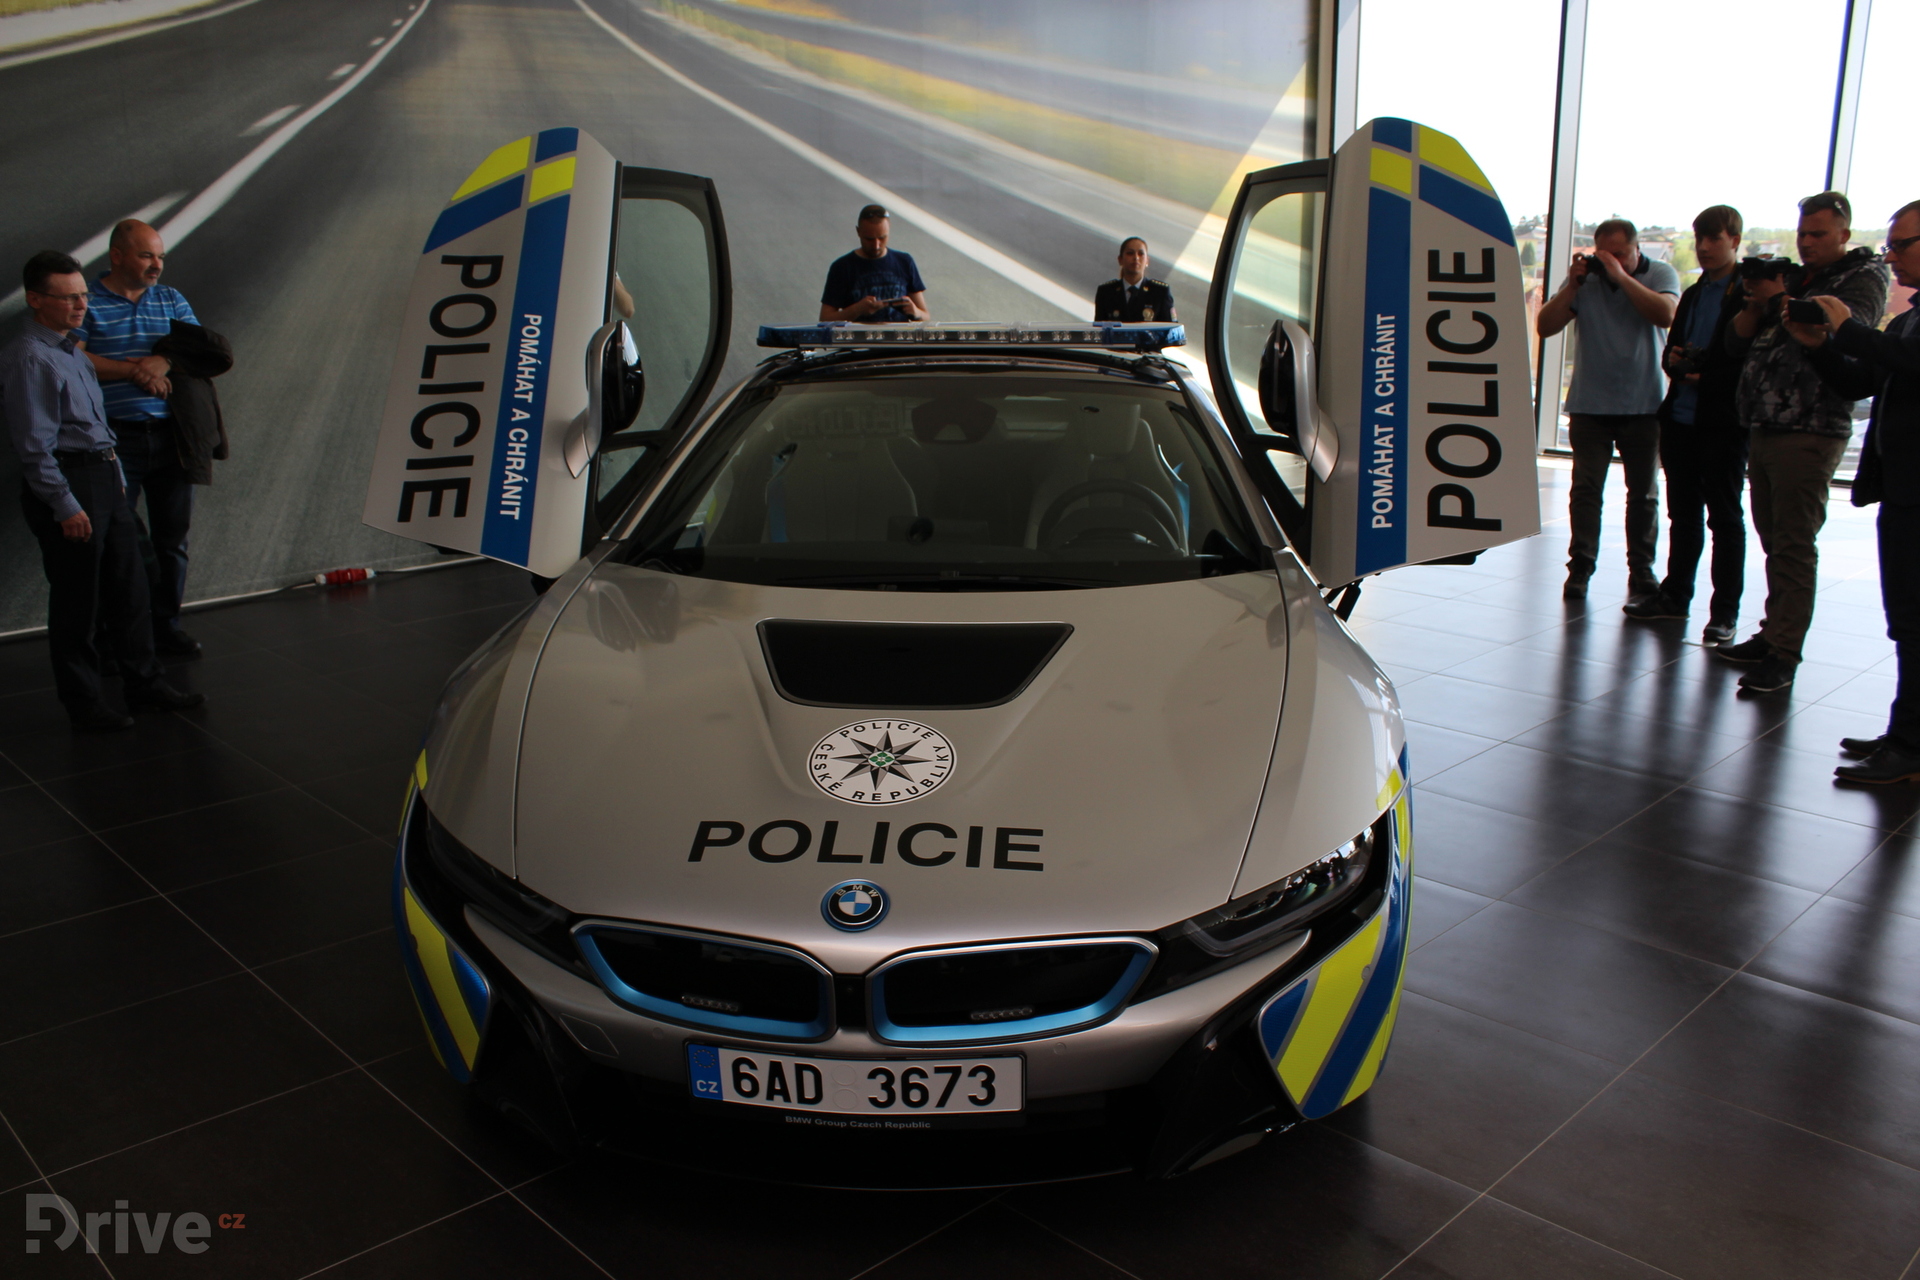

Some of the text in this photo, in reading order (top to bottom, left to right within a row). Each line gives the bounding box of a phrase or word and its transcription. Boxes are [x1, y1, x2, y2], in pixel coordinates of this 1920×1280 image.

[397, 254, 504, 523] POLICIE
[1424, 247, 1502, 532] POLICIE
[499, 313, 541, 520] POMÁHAT A CHRÁNIT
[1368, 313, 1396, 529] POMÁHAT A CHRÁNIT
[839, 721, 934, 740] POLICIE
[813, 743, 949, 801] ČESKÉ REPUBLIKY
[687, 819, 1044, 872] POLICIE
[835, 884, 879, 898] BMW
[696, 1079, 719, 1094] CZ
[731, 1056, 997, 1109] 6AD 3673
[785, 1115, 931, 1129] BMW Group Czech Republic
